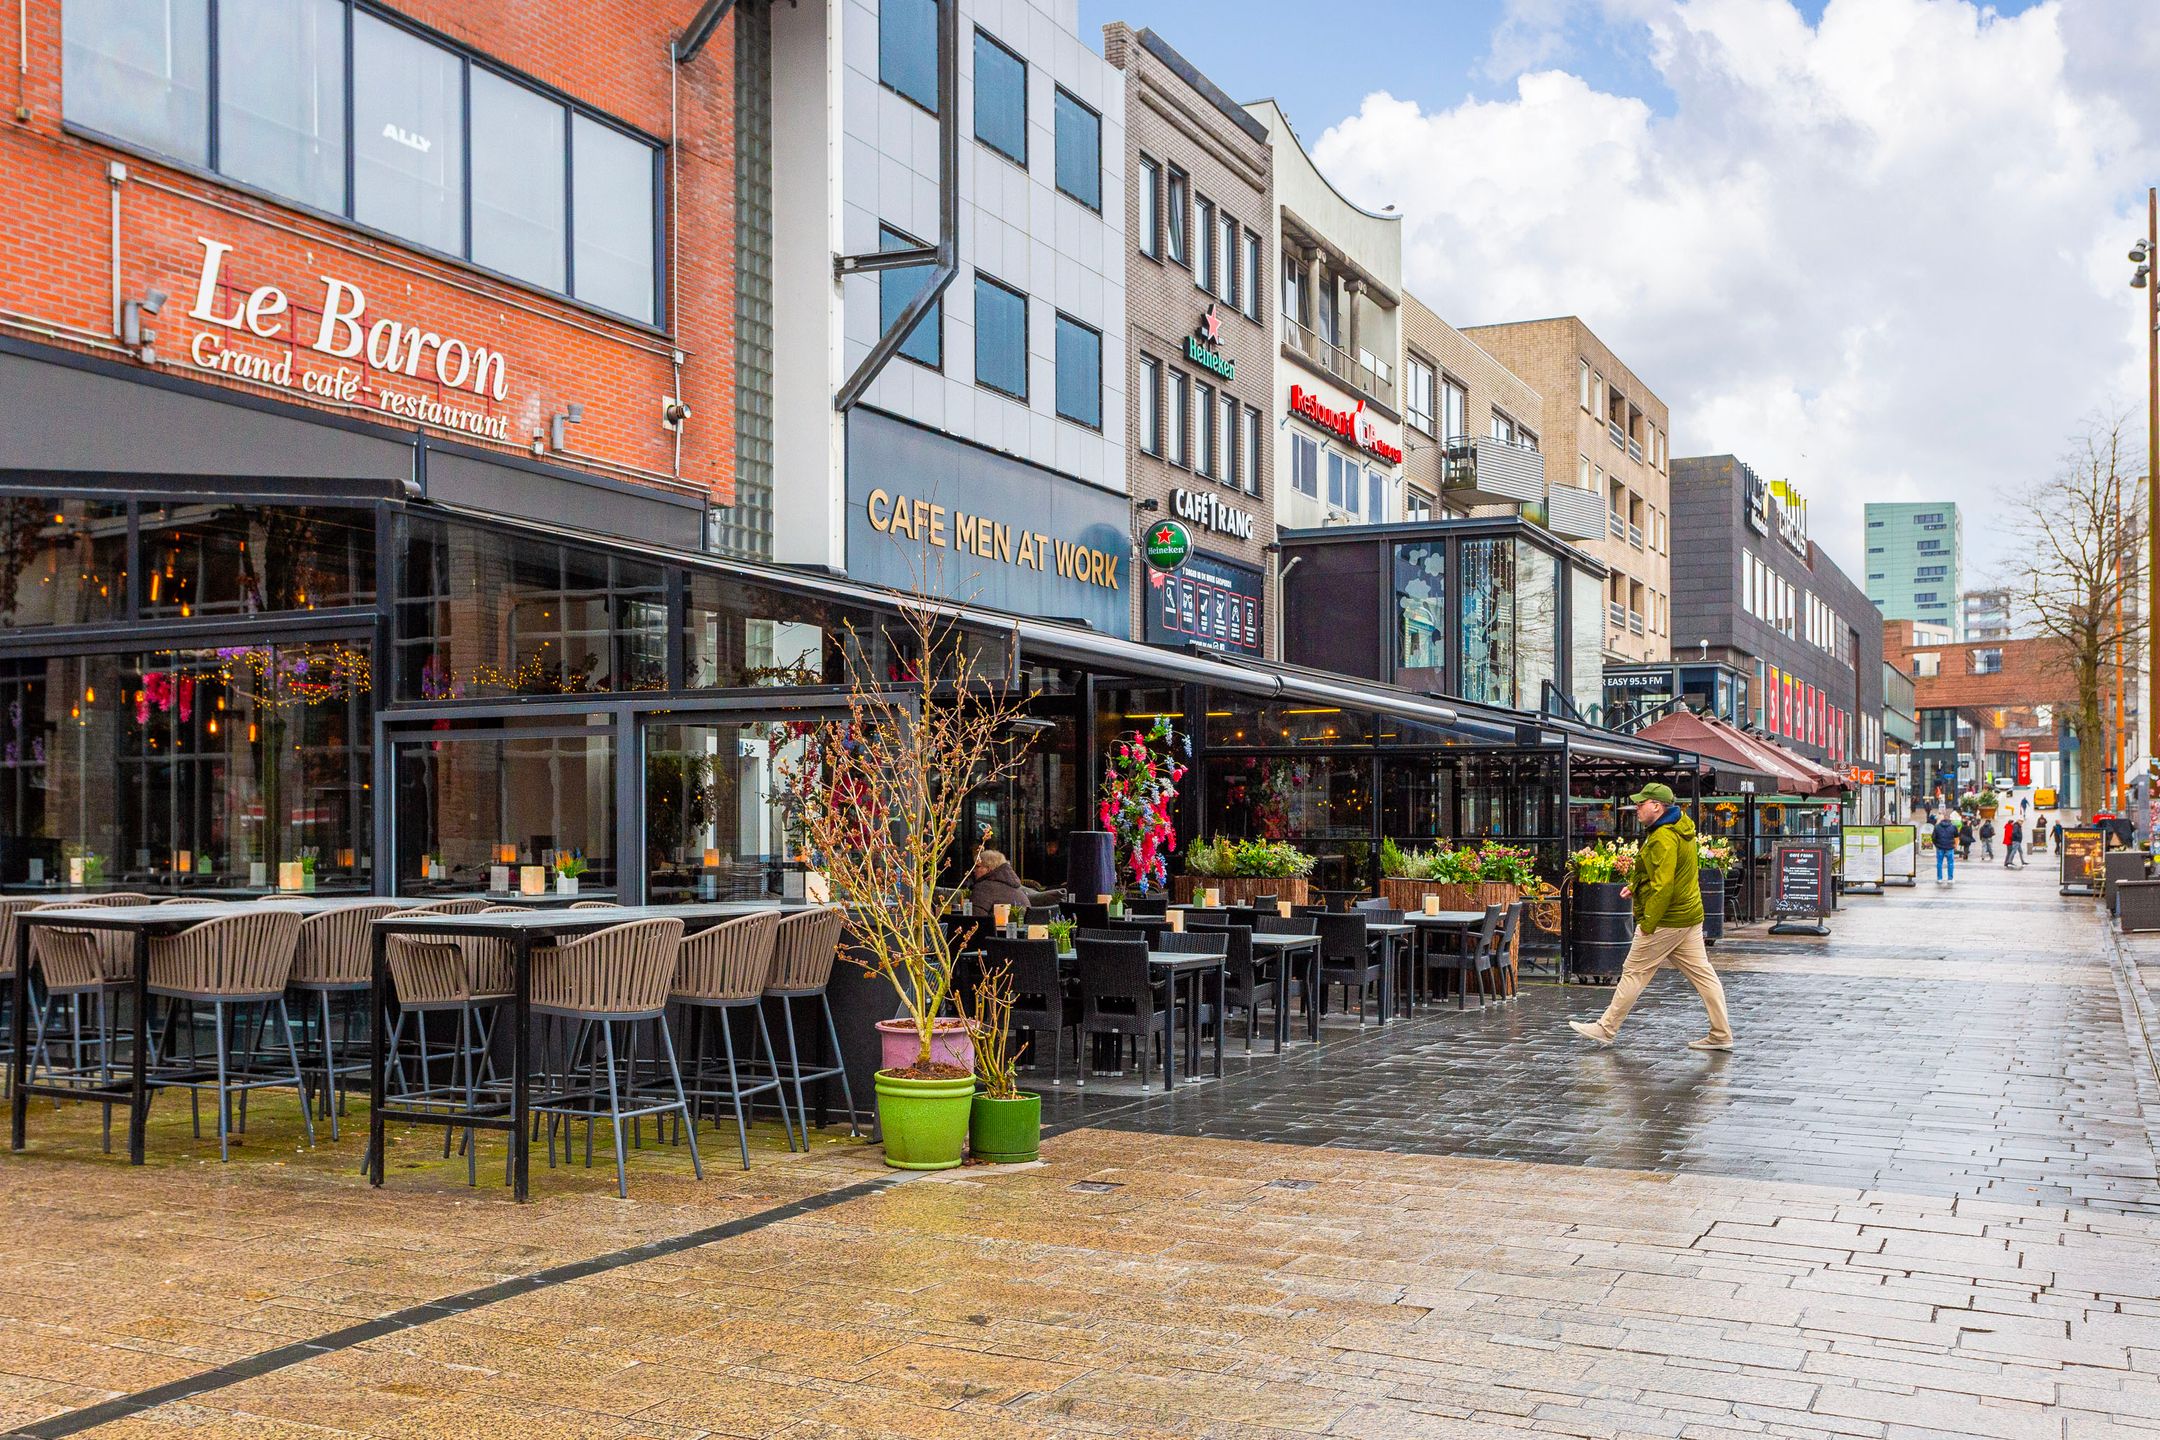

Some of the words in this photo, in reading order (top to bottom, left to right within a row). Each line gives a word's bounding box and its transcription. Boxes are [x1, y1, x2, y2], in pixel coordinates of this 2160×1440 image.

[188, 236, 287, 337] Le
[313, 275, 508, 401] Baron
[1189, 336, 1236, 380] Heineken
[191, 332, 292, 387] Grand
[379, 389, 509, 440] restaurant
[1173, 488, 1208, 525] CAFÉ
[1208, 492, 1253, 540] TRANG
[1779, 510, 1806, 557] CIRCUS
[868, 488, 946, 547] CAFE
[955, 511, 1010, 563] MEN
[1016, 530, 1048, 571] AT
[1054, 539, 1119, 590] WORK
[1148, 546, 1184, 554] Heineken
[1607, 677, 1628, 686] EASY
[1629, 677, 1648, 685] 95.5
[1649, 676, 1663, 685] FM
